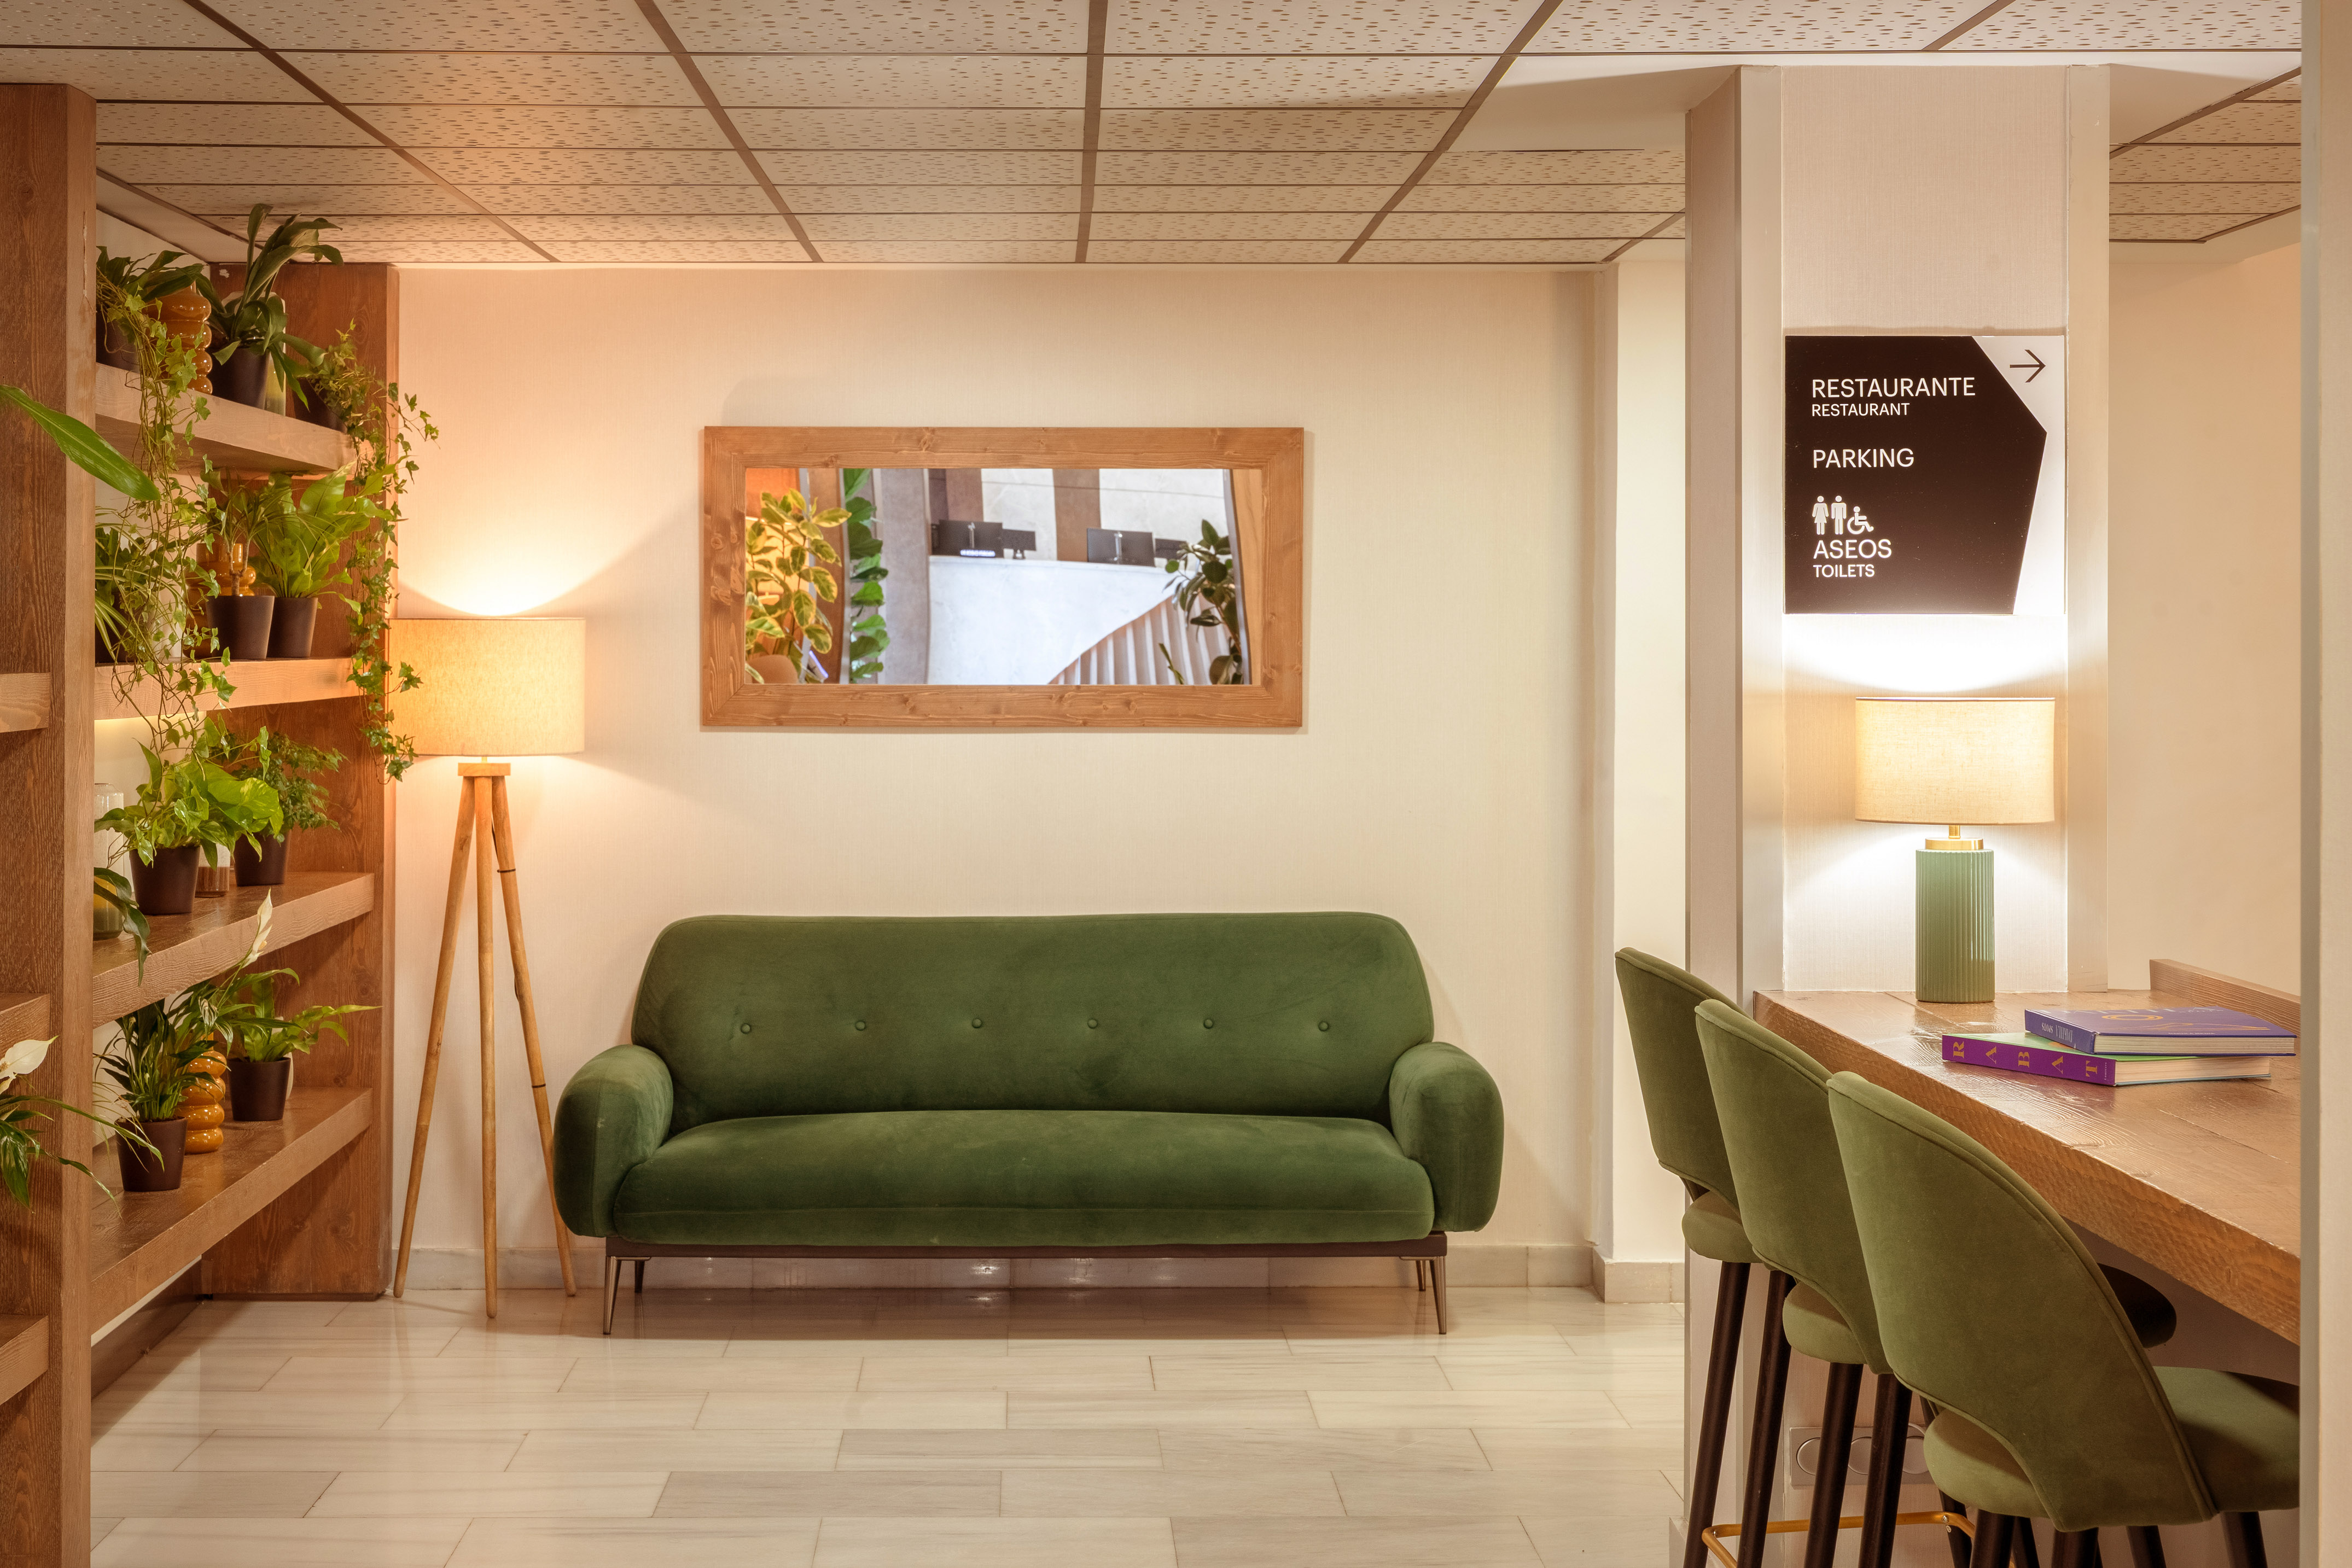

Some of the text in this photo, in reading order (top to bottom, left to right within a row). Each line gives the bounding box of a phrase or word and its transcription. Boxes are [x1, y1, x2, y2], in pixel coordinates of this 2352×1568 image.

[1812, 377, 1976, 398] RESTAURANTE
[1812, 403, 1910, 417] RESTAURANT
[1813, 448, 1914, 469] PARKING
[1813, 538, 1892, 559] ASEOS
[1813, 563, 1875, 578] TOILETS
[2041, 1022, 2053, 1033] SPOTS
